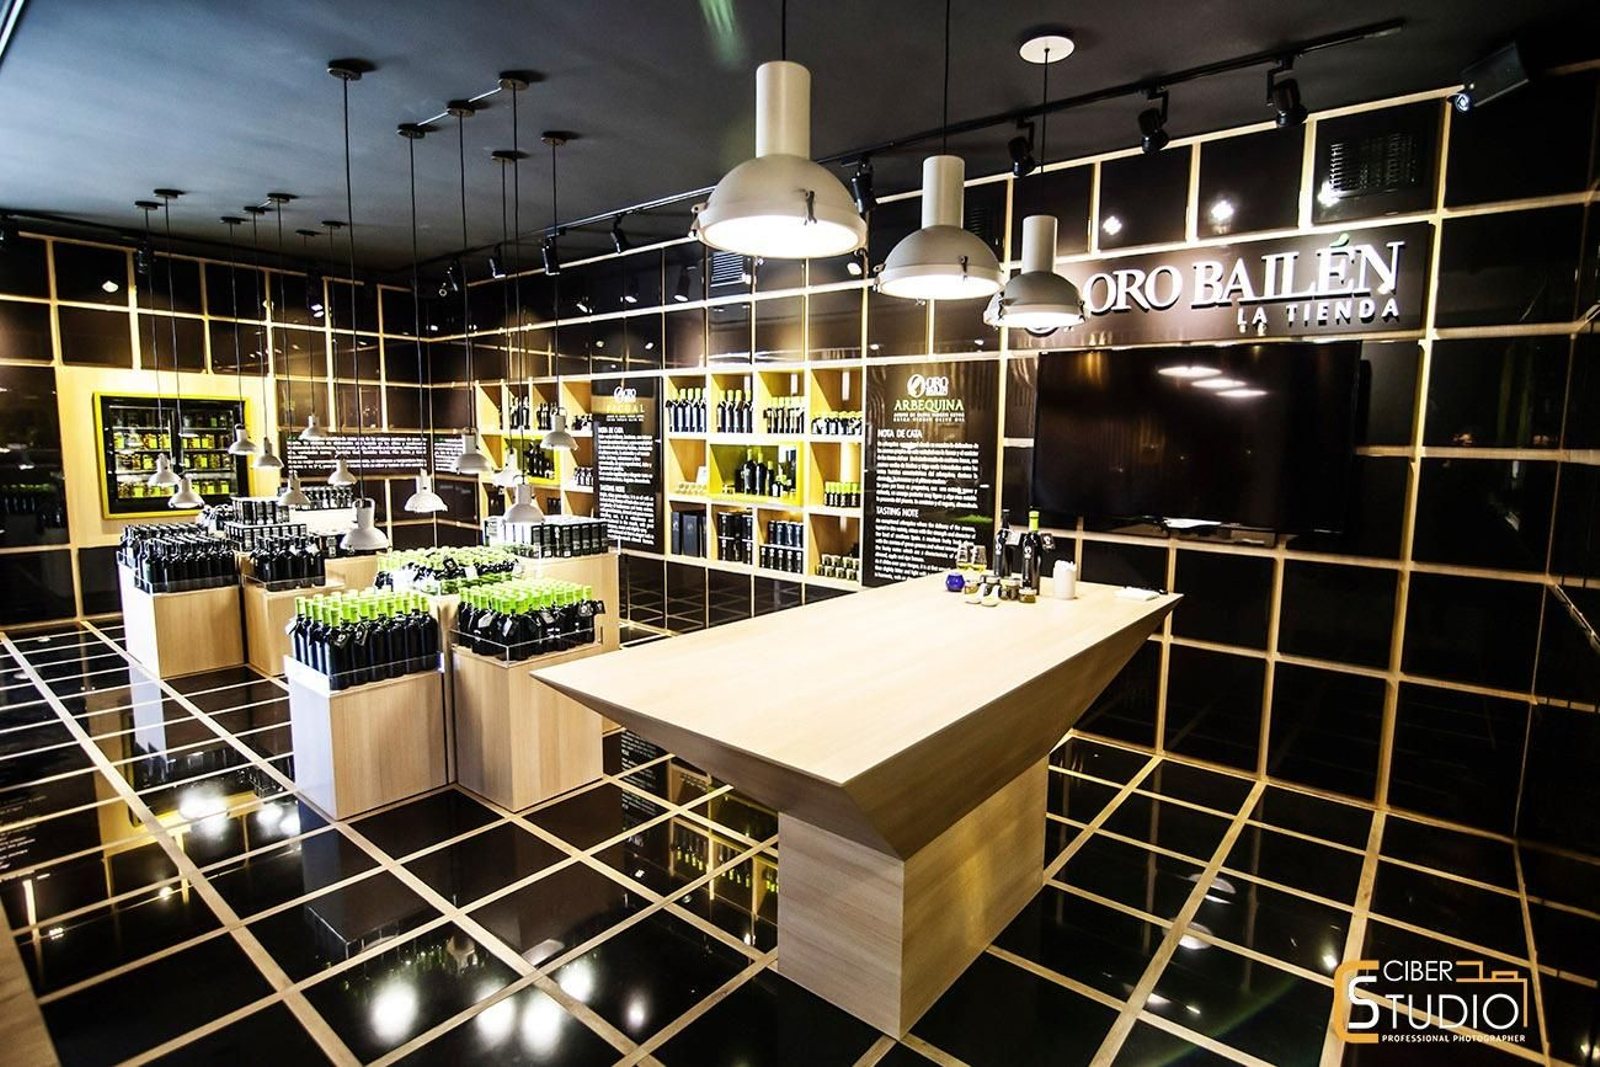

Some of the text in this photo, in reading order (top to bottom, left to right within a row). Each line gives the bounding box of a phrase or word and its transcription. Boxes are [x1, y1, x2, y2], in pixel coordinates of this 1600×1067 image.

[1082, 233, 1405, 315] ORO BAILÉN
[1237, 299, 1400, 326] LA TIENDA
[893, 399, 965, 413] ARBEQUINA
[896, 429, 906, 438] DE
[875, 505, 901, 517] TASTING
